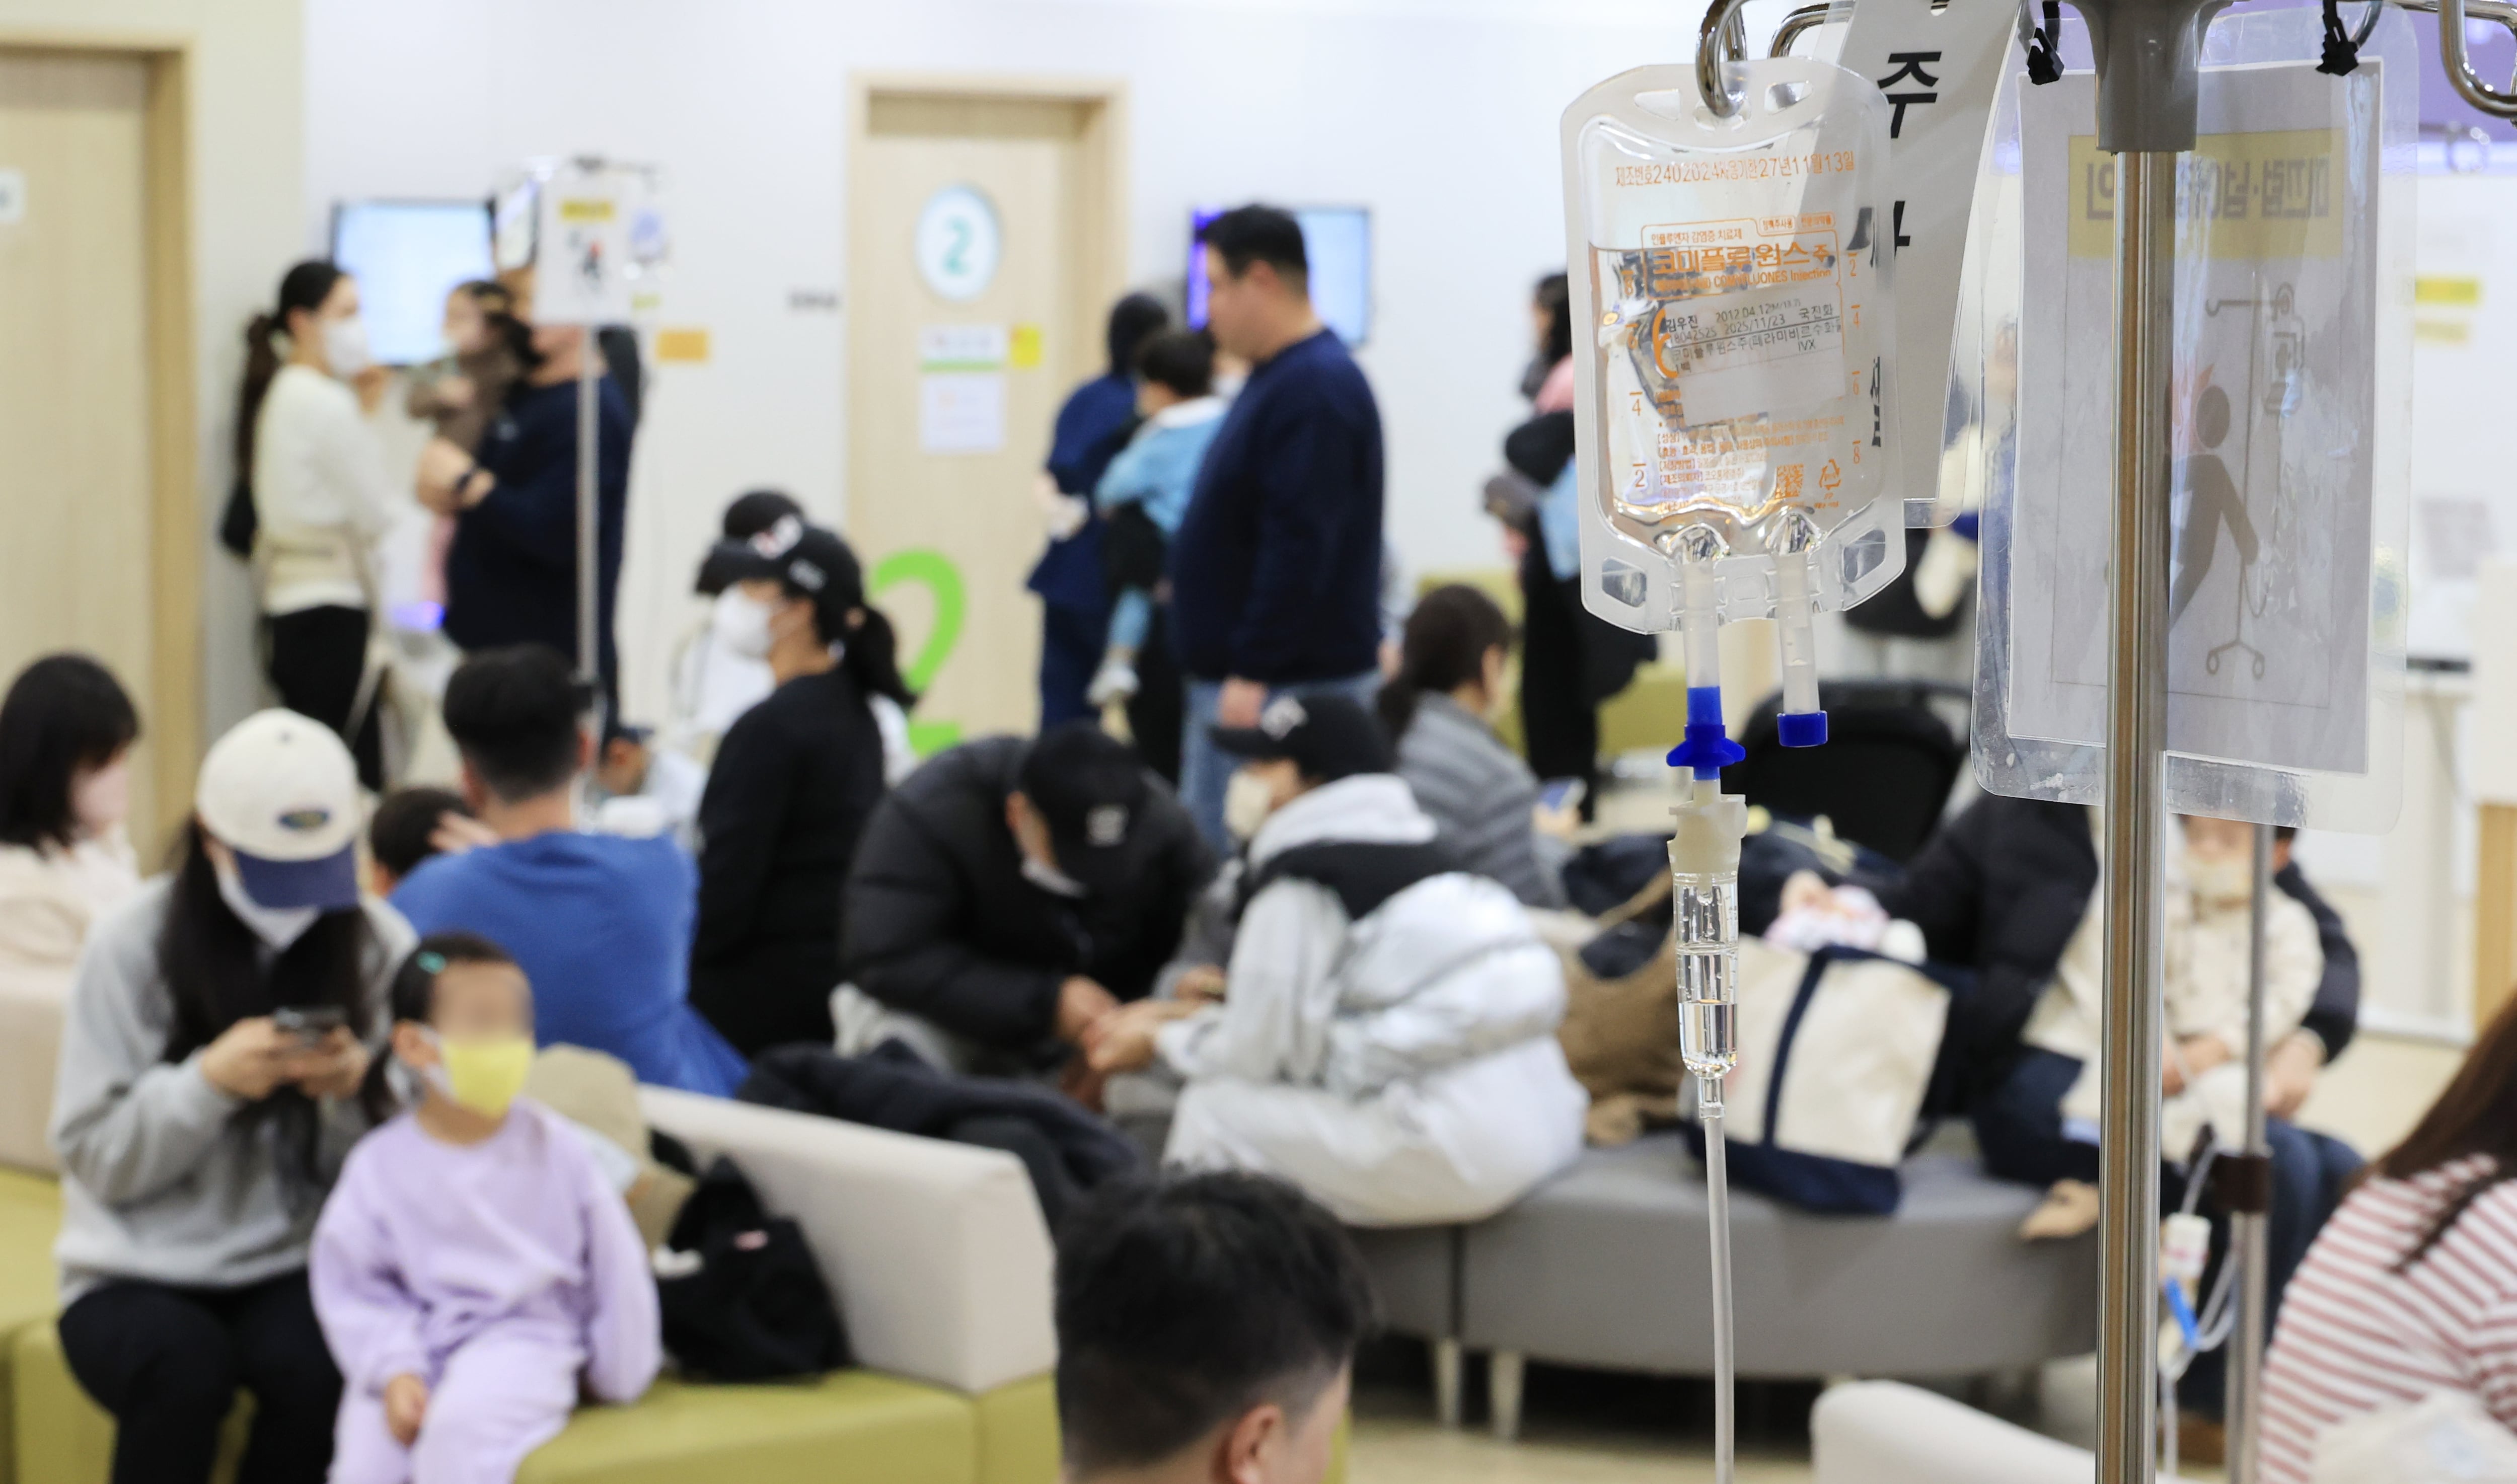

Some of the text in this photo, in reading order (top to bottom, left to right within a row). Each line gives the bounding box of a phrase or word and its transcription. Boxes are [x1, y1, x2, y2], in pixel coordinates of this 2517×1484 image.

[940, 212, 975, 278] 2
[1651, 230, 1689, 246] 인플루엔자
[1718, 228, 1742, 241] 치료제
[1790, 267, 1831, 282] Injection
[1849, 258, 1857, 277] 2
[1853, 311, 1860, 329] 4
[1632, 398, 1642, 416] 4
[1635, 469, 1645, 488] 2
[871, 546, 968, 761] 2
